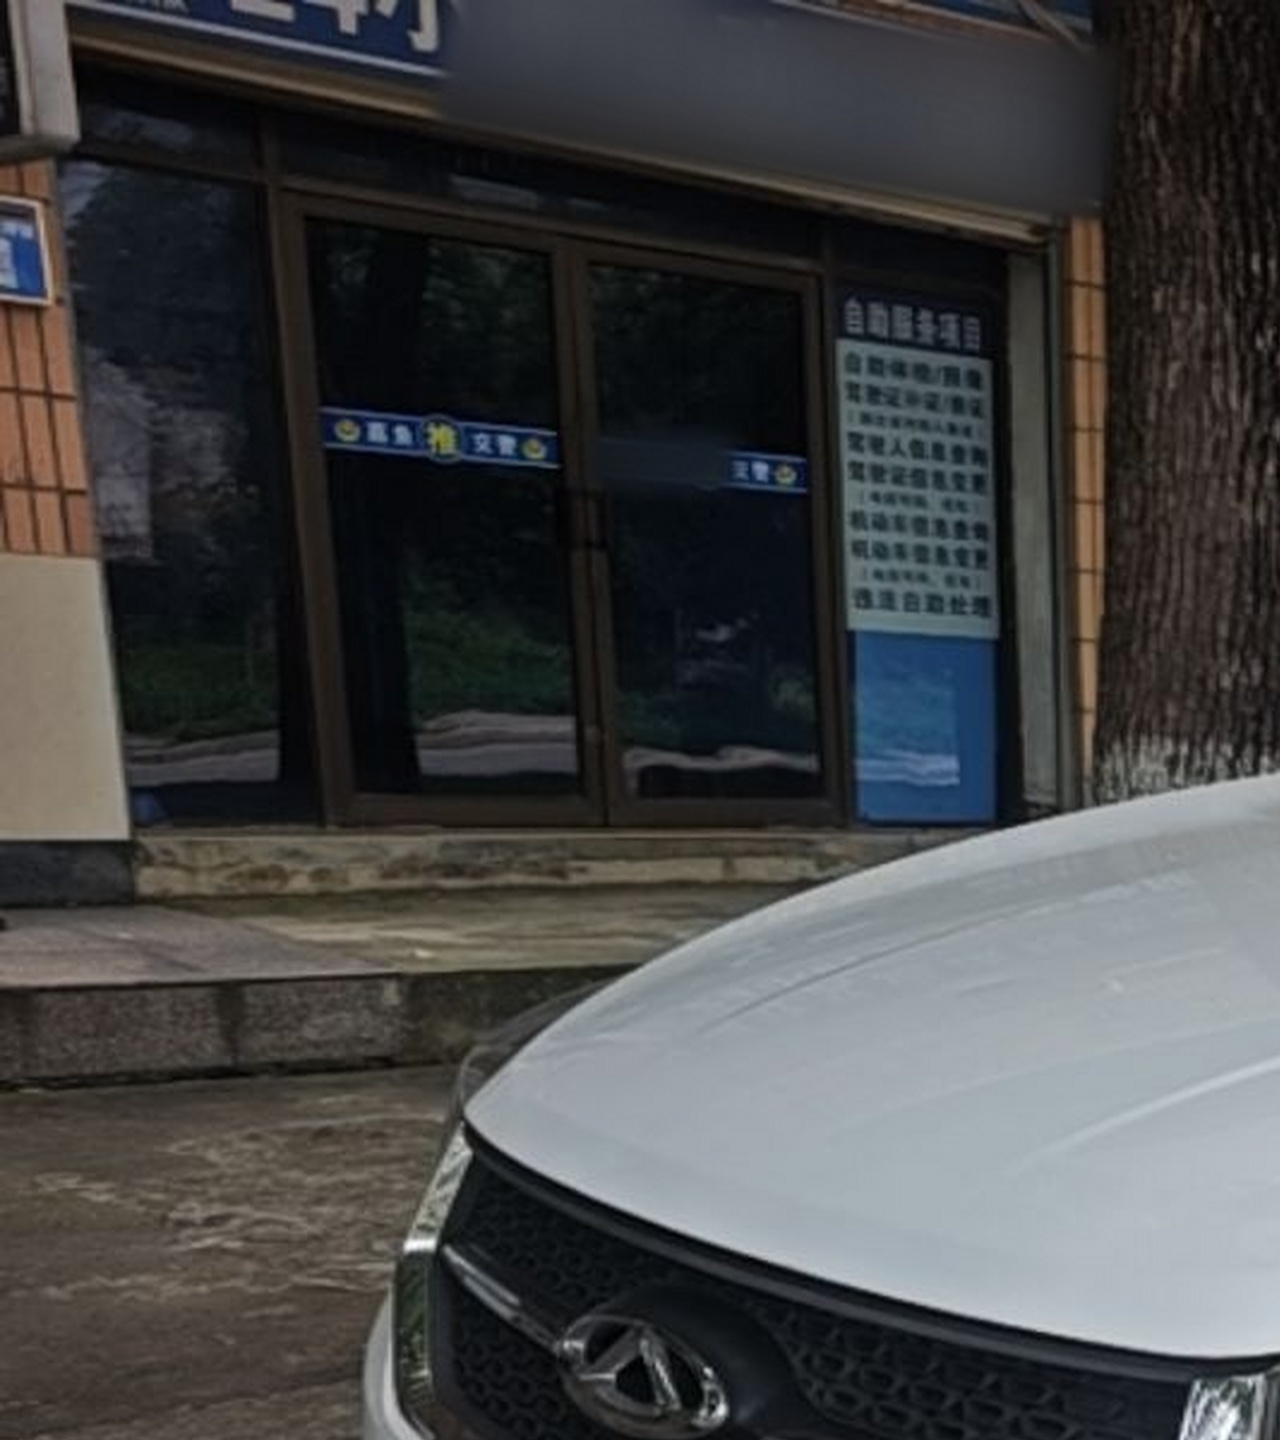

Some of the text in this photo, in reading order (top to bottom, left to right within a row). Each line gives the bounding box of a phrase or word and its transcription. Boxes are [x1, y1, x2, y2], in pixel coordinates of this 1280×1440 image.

[843, 297, 981, 351] 自助服务项目
